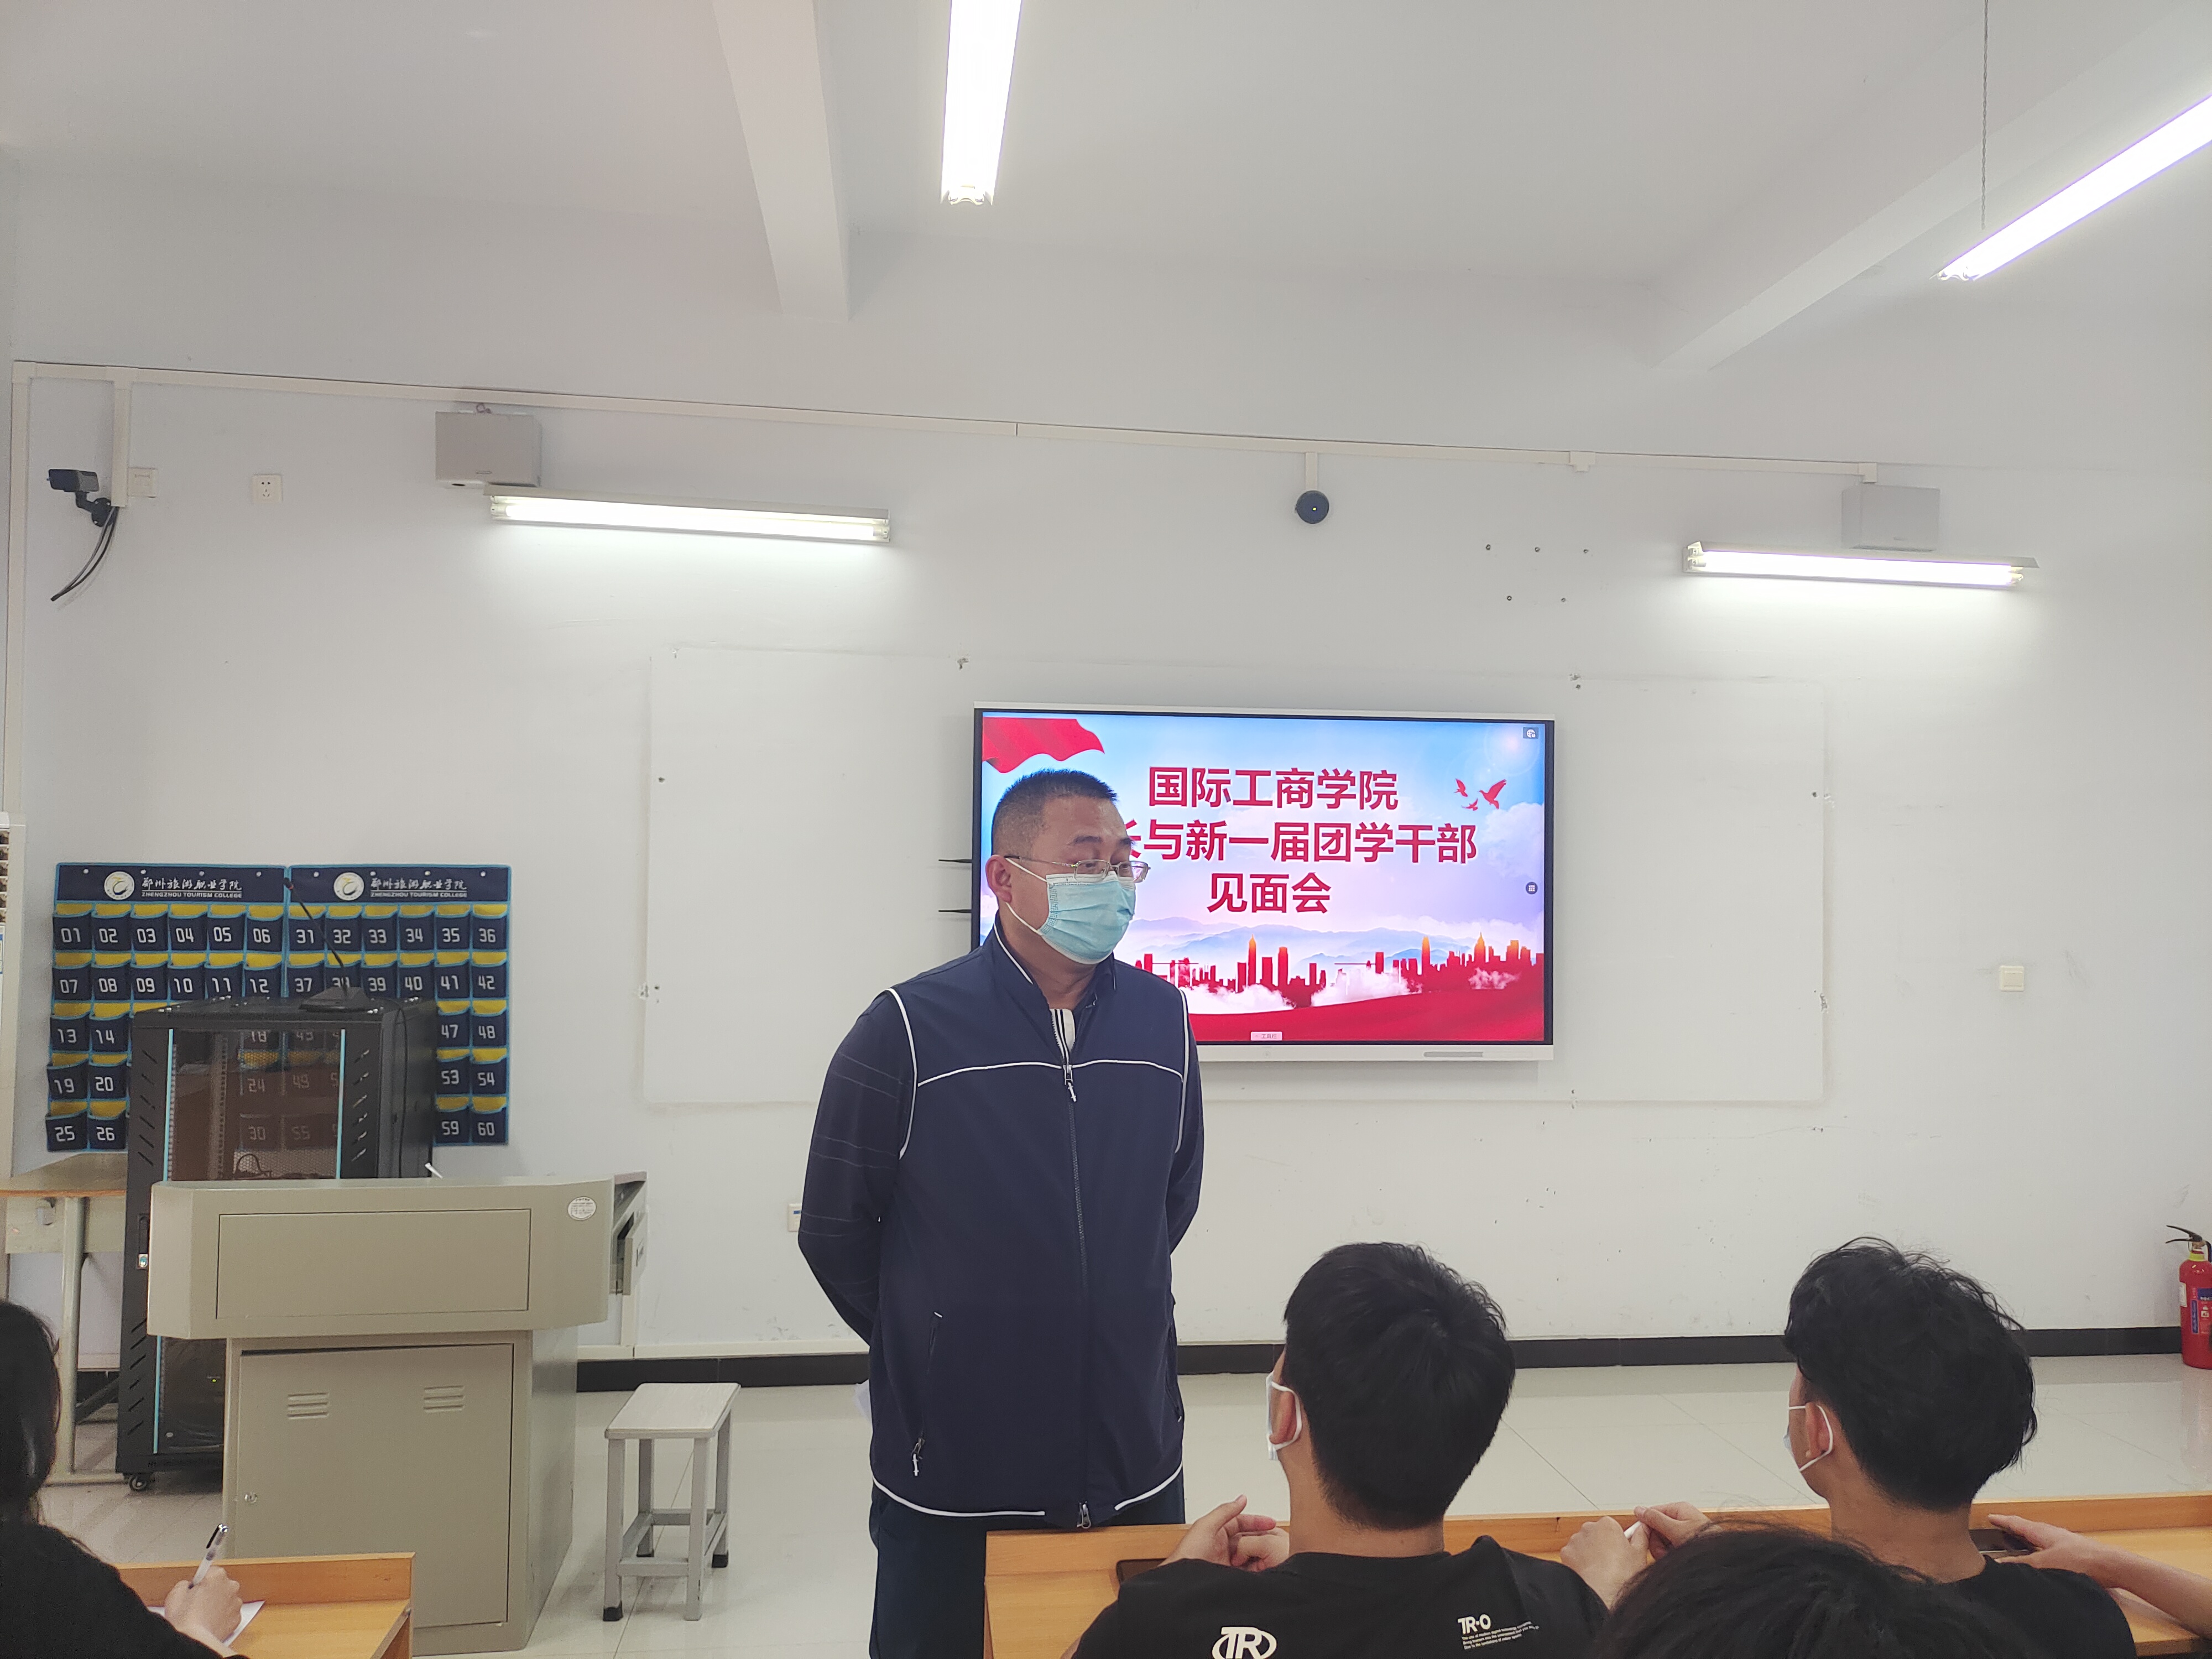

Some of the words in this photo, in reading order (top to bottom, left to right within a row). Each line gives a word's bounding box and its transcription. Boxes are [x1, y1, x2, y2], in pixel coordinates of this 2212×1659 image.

[1149, 766, 1398, 810] 国际工商学院
[1207, 872, 1331, 914] 见面会
[61, 927, 81, 943] 01
[98, 928, 118, 943] 02
[137, 928, 156, 943] 03
[175, 928, 194, 943] 04
[213, 926, 232, 942] 05
[253, 928, 270, 943] 06
[296, 929, 314, 943] 31
[333, 929, 351, 944] 32
[368, 929, 387, 943] 33
[405, 928, 423, 943] 34
[442, 927, 460, 942] 35
[479, 928, 496, 943] 36
[60, 979, 78, 994] 07
[98, 978, 118, 993] 08
[136, 978, 155, 993] 09
[174, 978, 193, 993] 10
[212, 977, 231, 993] 11
[249, 978, 269, 993] 12
[295, 977, 312, 993] 37
[368, 977, 386, 992] 39
[405, 976, 422, 990] 40
[441, 975, 458, 990] 41
[478, 975, 495, 990] 42
[57, 1029, 77, 1043] 13
[96, 1029, 114, 1044] 14
[441, 1024, 458, 1039] 47
[478, 1025, 495, 1039] 48
[54, 1078, 75, 1094] 19
[95, 1076, 114, 1092] 20
[248, 1078, 265, 1092] 24
[441, 1070, 460, 1084] 53
[478, 1072, 495, 1086] 54
[55, 1125, 75, 1142] 25
[96, 1126, 115, 1141] 26
[248, 1126, 266, 1141] 30
[442, 1120, 459, 1135] 59
[478, 1122, 495, 1136] 60
